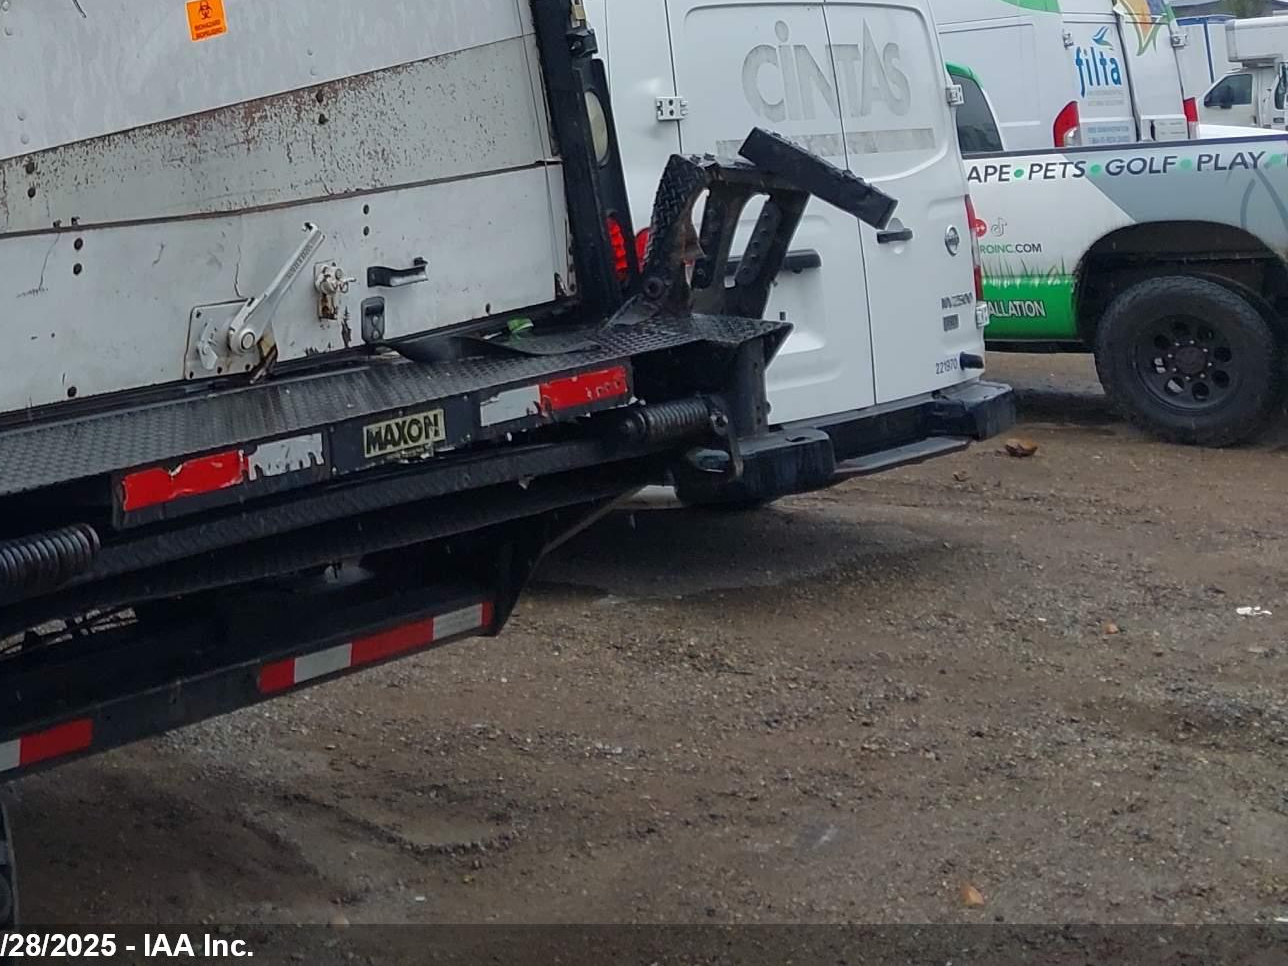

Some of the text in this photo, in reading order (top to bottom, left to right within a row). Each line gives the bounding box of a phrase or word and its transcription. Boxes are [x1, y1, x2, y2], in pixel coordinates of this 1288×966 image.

[1075, 46, 1122, 98] filta
[1028, 160, 1087, 181] PETS
[1105, 155, 1178, 177] GOLF
[1197, 150, 1266, 172] PLAY
[366, 414, 441, 455] MAXON
